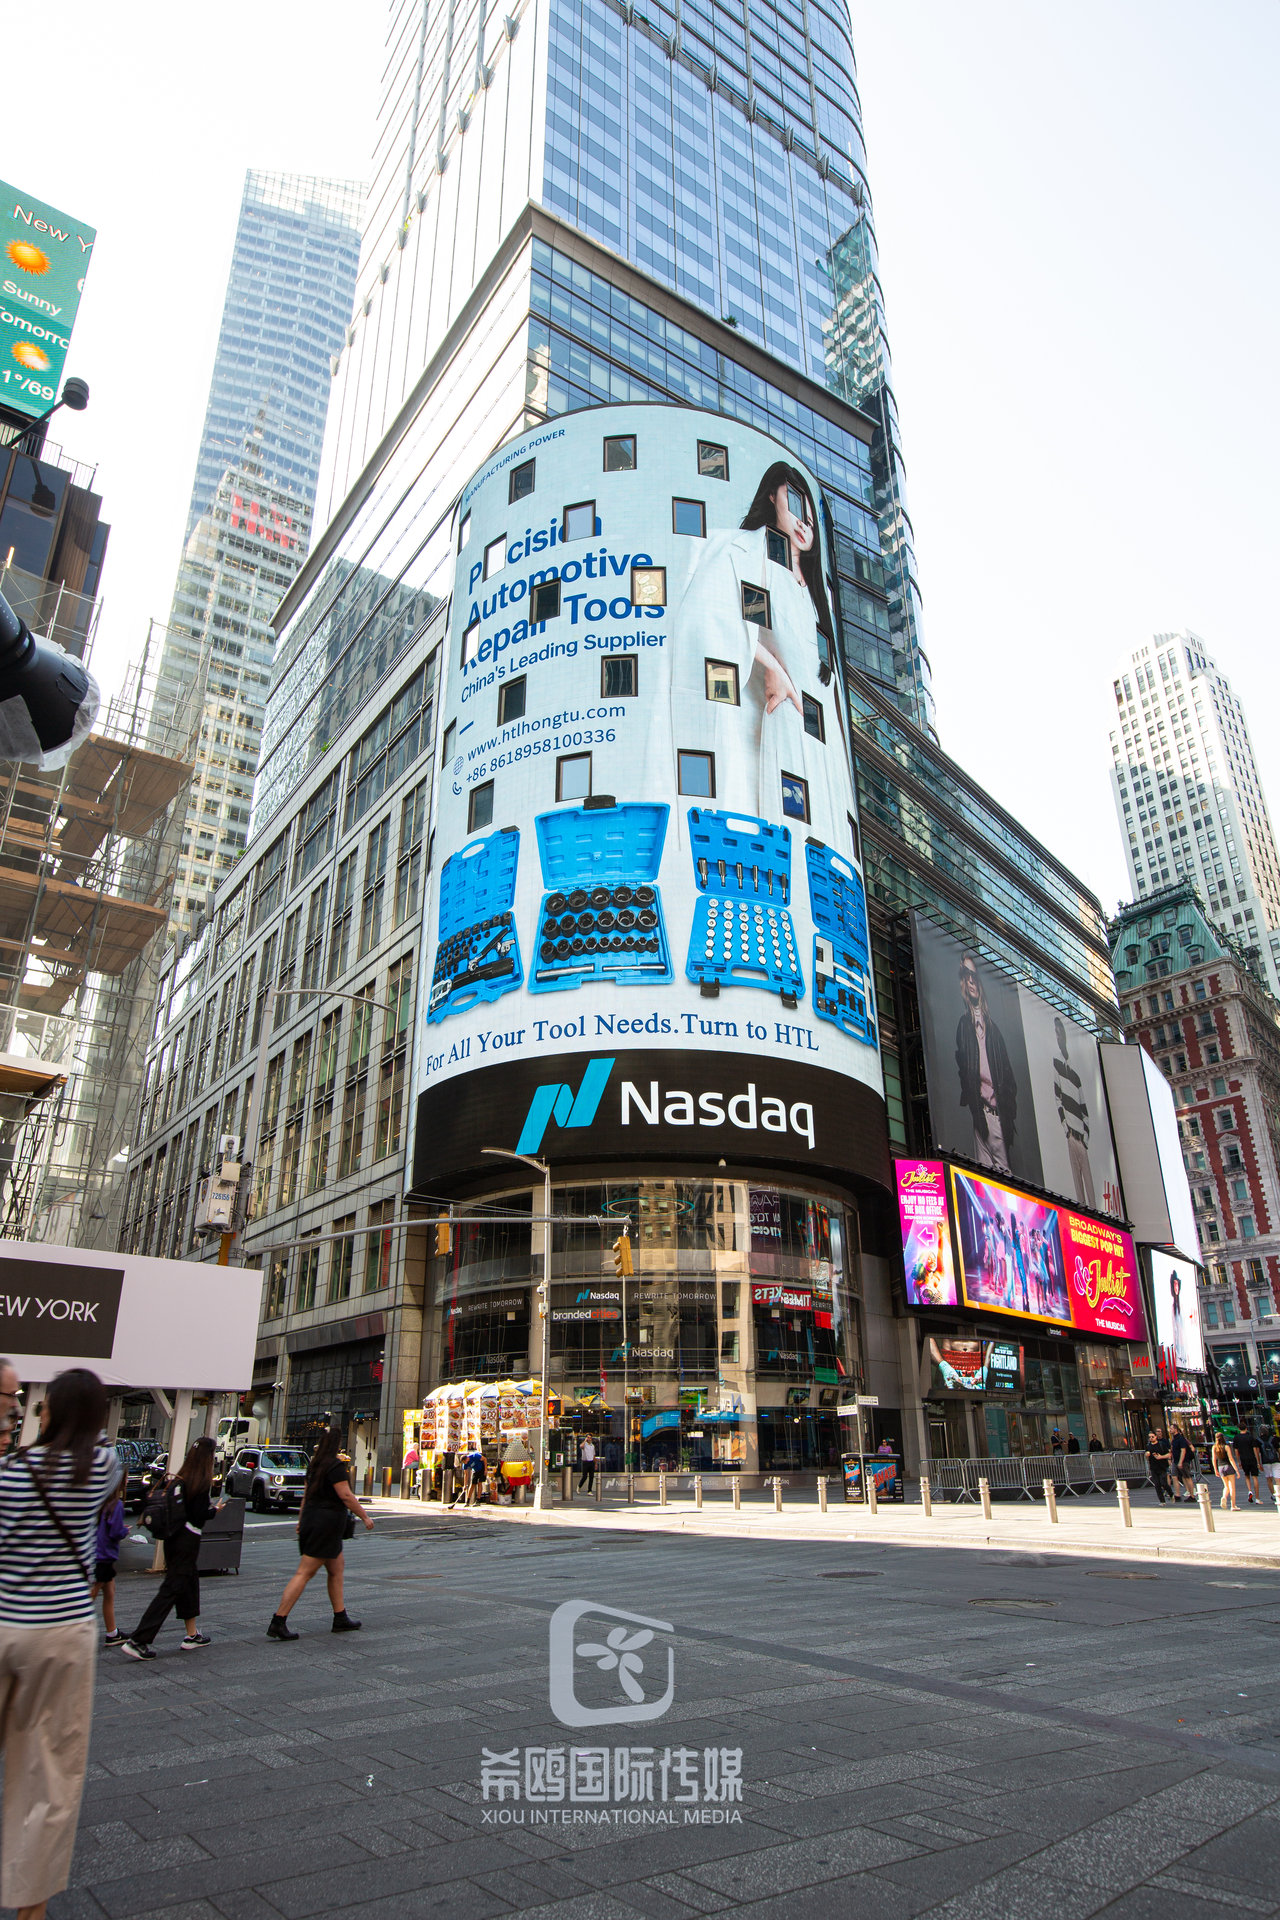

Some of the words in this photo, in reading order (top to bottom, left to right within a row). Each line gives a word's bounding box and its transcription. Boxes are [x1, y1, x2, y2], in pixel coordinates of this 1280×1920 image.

[13, 204, 71, 242] New
[2, 279, 62, 317] Sunny
[465, 445, 527, 501] MANUFACTURING
[528, 429, 566, 450] POWER
[468, 516, 602, 596] Pcisi
[461, 665, 506, 703] China's
[510, 640, 578, 673] Leading
[583, 631, 667, 651] Supplier
[467, 706, 626, 761] www.htlhongtu.com
[466, 763, 487, 783] +86
[490, 728, 616, 773] 8618958100336
[426, 1054, 444, 1076] For
[447, 1037, 471, 1065] All
[477, 1029, 526, 1053] Your
[532, 1015, 586, 1042] Tool
[746, 1020, 767, 1041] to
[774, 1022, 820, 1051] HTL
[621, 1080, 816, 1150] Nasdaq
[1069, 1216, 1123, 1243] BROADWAY'S
[1070, 1228, 1100, 1249] BIGGEST
[1099, 1239, 1114, 1254] POP
[590, 1292, 620, 1301] Nasdaq
[673, 1292, 717, 1301] TOMORROW
[1086, 1259, 1131, 1308] Juliet
[0, 1294, 30, 1318] EW
[35, 1297, 100, 1323] YORK
[468, 1302, 488, 1313] REWRITE
[490, 1298, 523, 1309] TOMORROW
[552, 1308, 619, 1321] brandedcities
[1095, 1317, 1106, 1328] THE
[1105, 1320, 1127, 1332] MUSICAL
[632, 1347, 674, 1359] Nasdaq
[1132, 1356, 1149, 1368] H&M
